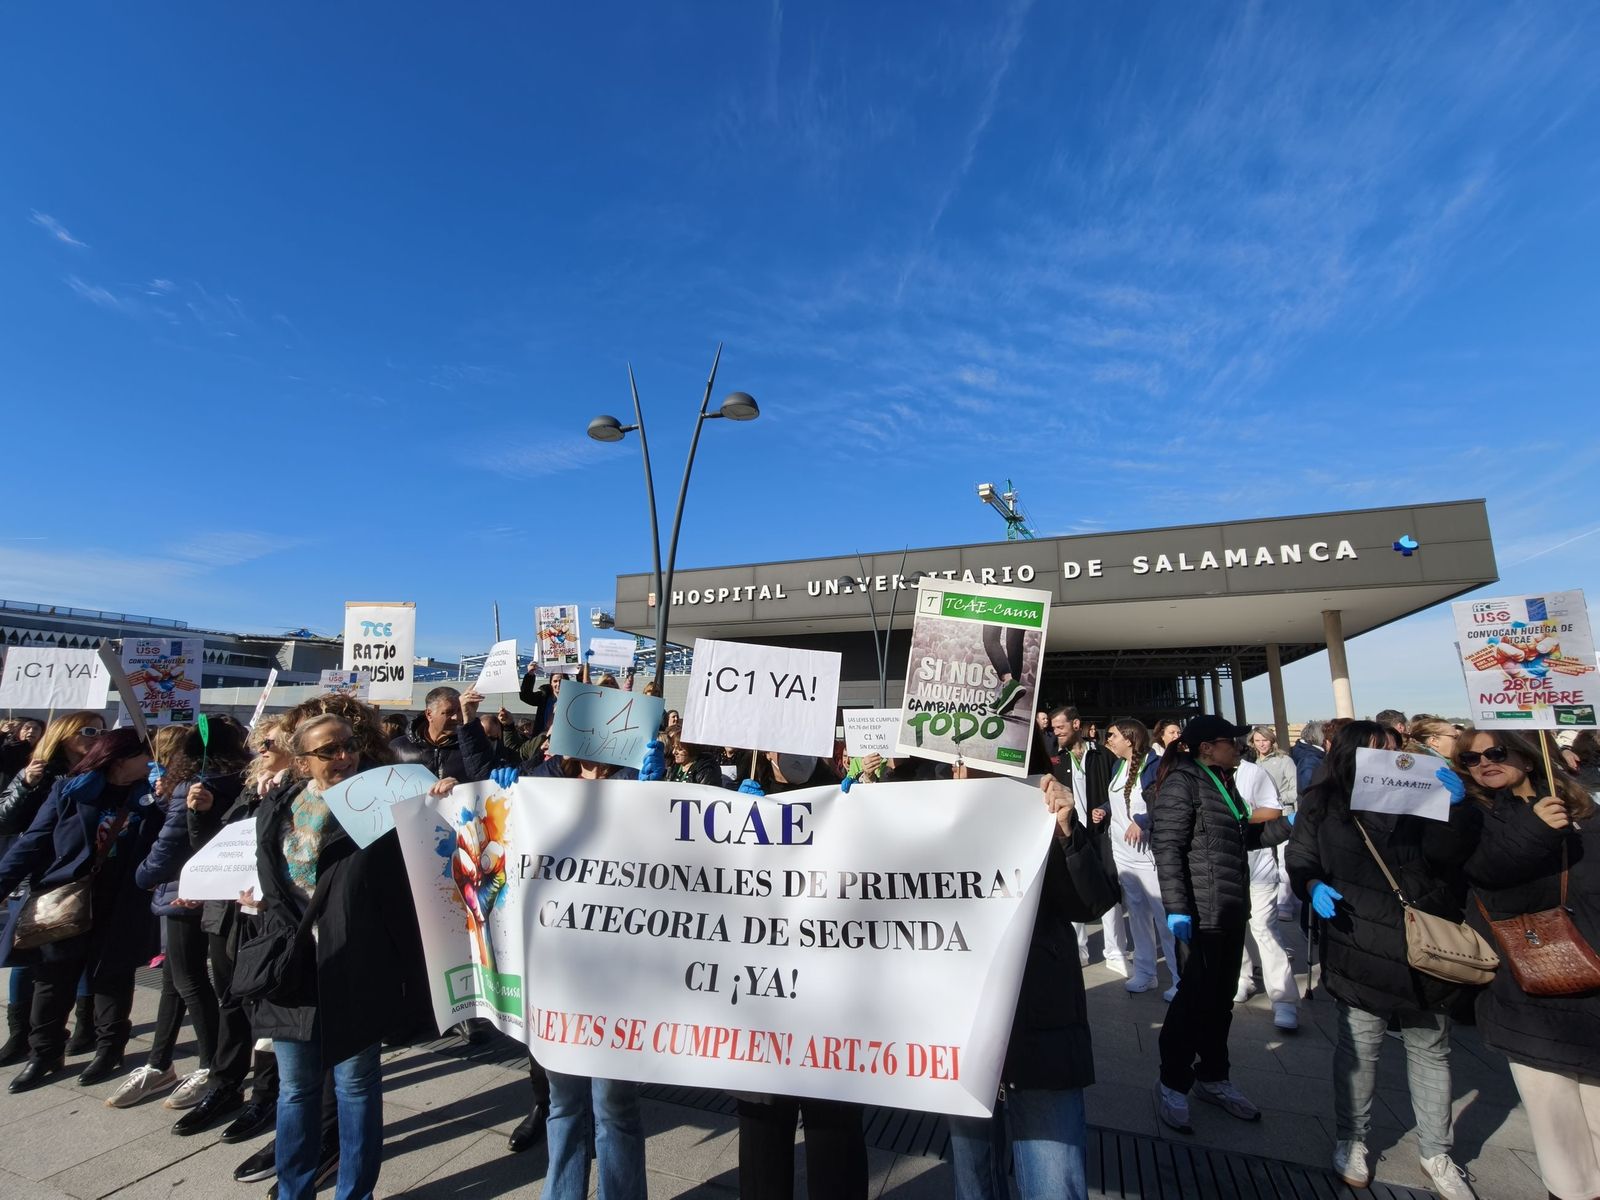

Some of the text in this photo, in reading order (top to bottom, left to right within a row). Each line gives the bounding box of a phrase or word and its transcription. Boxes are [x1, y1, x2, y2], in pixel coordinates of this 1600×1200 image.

[672, 583, 787, 606] HOSPITAL
[1064, 559, 1103, 580] DE
[1132, 540, 1358, 575] SALAMANCA
[945, 598, 1039, 619] TCAE-Causa
[1473, 611, 1511, 623] USO
[360, 620, 393, 637] TCE
[1467, 627, 1518, 639] CONVOCAN
[1521, 624, 1557, 635] HUELGA
[1560, 623, 1574, 632] DE
[1509, 636, 1531, 645] TCAE
[136, 647, 160, 655] USO
[15, 662, 99, 681] ¡C1 YA!
[919, 656, 998, 689] SI NOS
[705, 666, 817, 702] ¡C1 YA!
[917, 681, 997, 704] MOVEMOS
[1503, 677, 1554, 691] 28 DE
[139, 700, 191, 709] OVIEMBRE
[143, 691, 158, 700] 28
[1480, 690, 1585, 705] NOVIEMBRE
[566, 691, 639, 735] C1
[908, 698, 988, 716] CAMBIAMOS
[875, 733, 886, 741] YA!
[907, 712, 1005, 748] TODO
[1363, 776, 1374, 784] C1
[670, 799, 814, 846] TCAE
[782, 869, 828, 898] DE
[837, 868, 1025, 900] PRIMERA!
[539, 899, 972, 952] CATEGORIA DE SEGUNDA
[685, 961, 799, 1006] C1 ¡YA!
[537, 1008, 608, 1048] LEYES
[610, 1016, 647, 1051] SE
[652, 1021, 794, 1066] CUMPLEN!
[799, 1034, 898, 1076] ART.76
